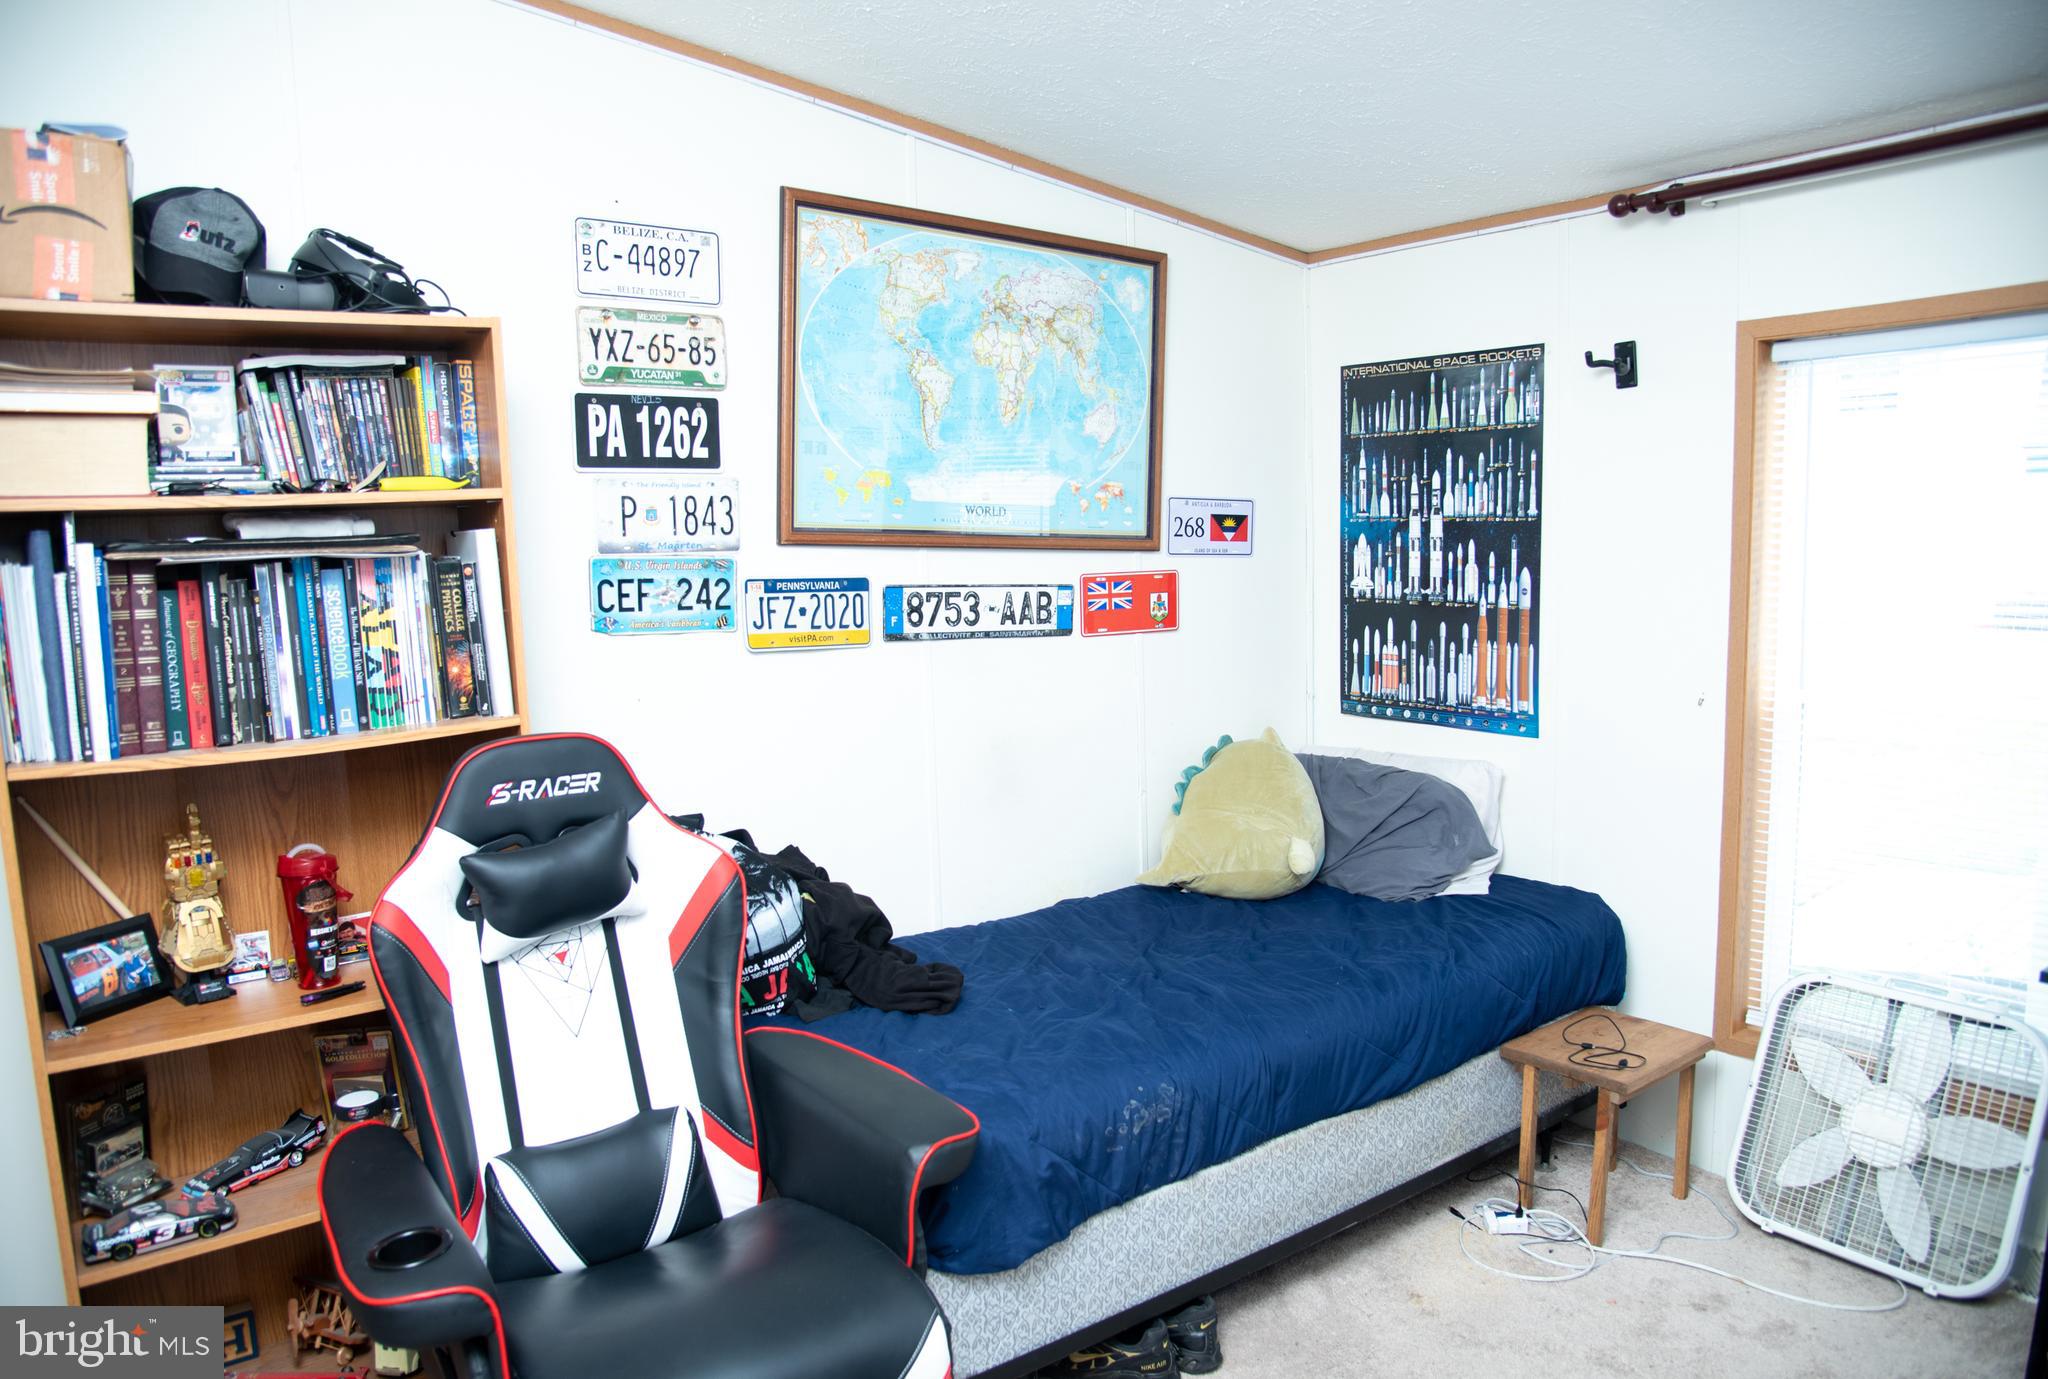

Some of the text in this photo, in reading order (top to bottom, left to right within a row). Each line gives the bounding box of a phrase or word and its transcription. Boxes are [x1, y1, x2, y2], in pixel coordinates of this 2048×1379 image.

[666, 232, 689, 243] C.A.
[596, 239, 700, 279] C-44897
[617, 285, 687, 298] BELIZE DISTRICT
[636, 312, 667, 322] MEXICO
[589, 327, 717, 366] YXZ-65-85
[630, 368, 674, 380] YUCATAN
[1343, 359, 1430, 376] INTERNATIONAL
[1433, 353, 1476, 367] SPACE
[1479, 347, 1542, 363] ROCKETS
[440, 370, 451, 428] HOLY BIBLE
[460, 364, 477, 434] SPACE
[587, 404, 709, 459] PA 1262
[621, 495, 734, 537] P 1843
[965, 505, 1007, 516] WORLD
[1174, 516, 1205, 538] 268
[657, 541, 703, 550] Maarten
[645, 561, 671, 573] Virgin
[673, 561, 703, 570] Islands
[304, 573, 315, 621] SCHOLASTIC
[597, 577, 731, 613] CEF 242
[776, 581, 840, 591] PENNSYLVANIA
[163, 596, 174, 630] Almanac
[441, 589, 455, 633] PHYSICS
[452, 589, 465, 632] COLLEGE
[891, 616, 898, 627] F
[263, 615, 273, 644] SUPER
[308, 624, 318, 645] ATLAS
[789, 634, 834, 643] visitPA.com
[120, 667, 127, 675] 2
[165, 640, 182, 712] GEOGRAPHY
[315, 677, 323, 705] WORLD
[486, 771, 602, 808] S-RACER
[325, 1051, 387, 1062] GOLD COLLECTION
[154, 1225, 177, 1244] 3
[1141, 1360, 1167, 1371] NIKE AIR
